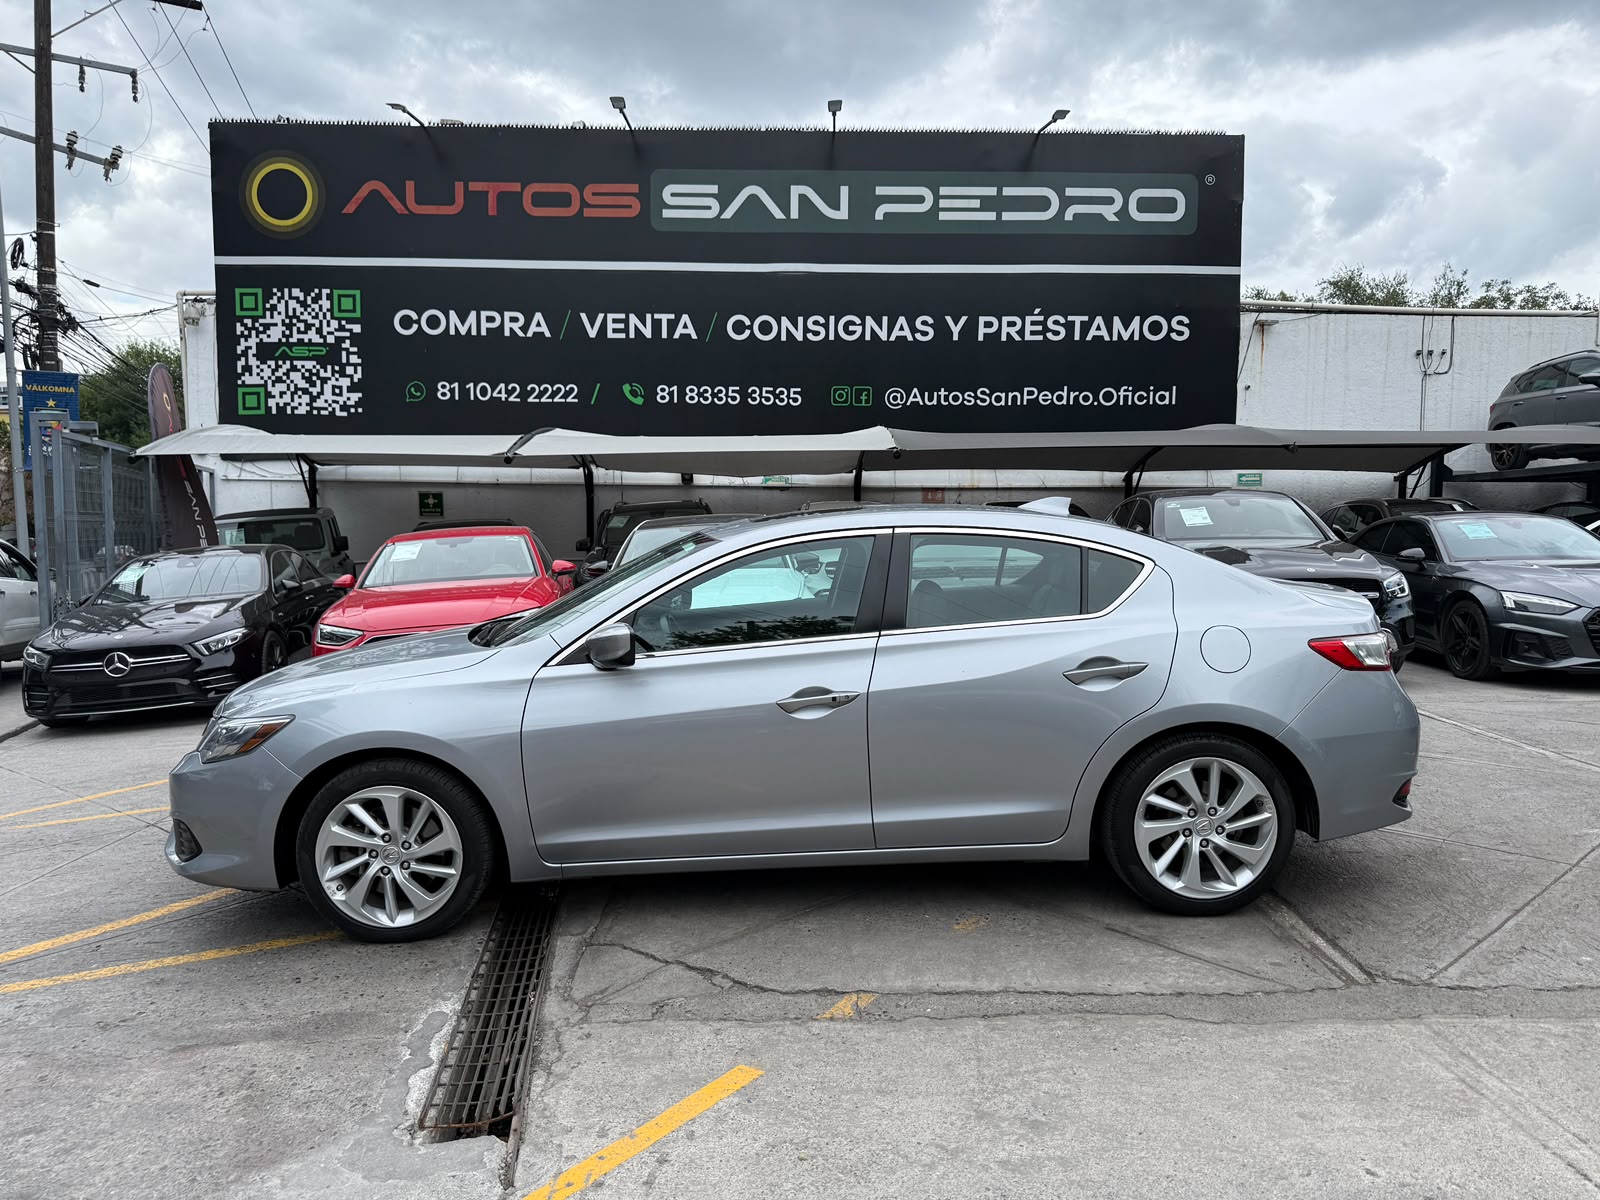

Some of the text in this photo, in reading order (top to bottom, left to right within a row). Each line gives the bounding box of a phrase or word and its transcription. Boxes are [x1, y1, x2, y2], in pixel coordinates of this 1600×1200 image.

[341, 179, 641, 218] AUTOS
[661, 183, 849, 220] SAN
[874, 186, 1186, 222] PEDRO
[393, 308, 552, 338] COMPRA
[579, 312, 698, 340] VENTA
[726, 314, 935, 342] CONSIGNAS
[944, 315, 969, 341] Y
[977, 307, 1190, 342] PRÉSTAMOS
[274, 346, 326, 357] ASP
[436, 381, 459, 400] 81
[465, 382, 521, 402] 1042
[526, 383, 579, 403] 2222
[656, 384, 678, 404] 81
[685, 385, 741, 405] 8335
[747, 386, 802, 407] 3535
[884, 385, 1177, 410] @AutosSanPedro.Oficial
